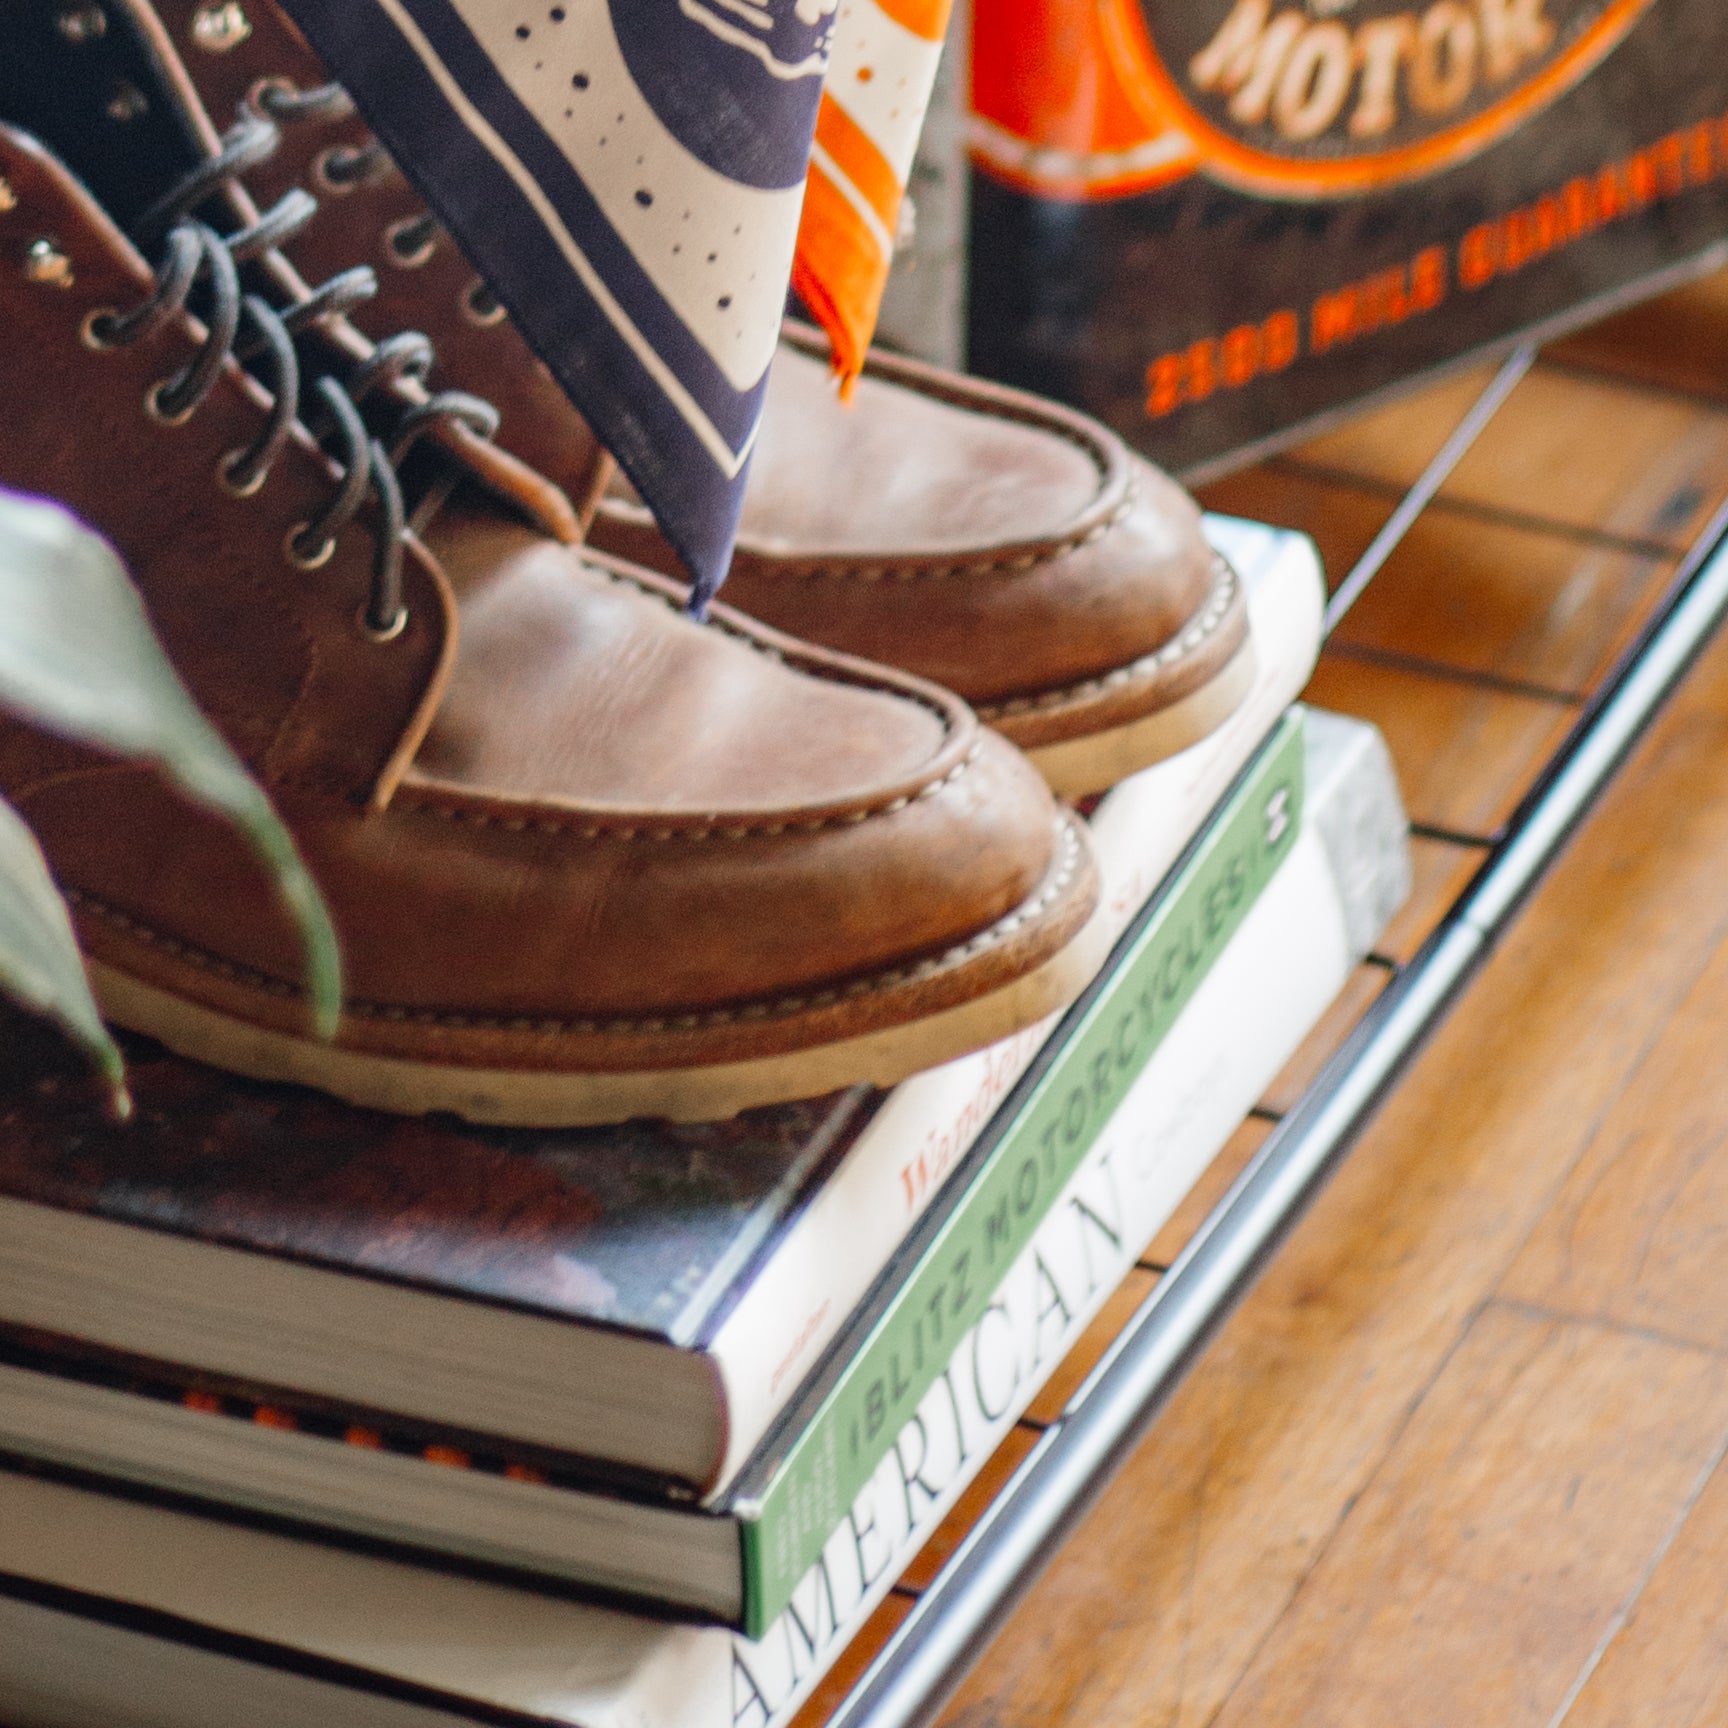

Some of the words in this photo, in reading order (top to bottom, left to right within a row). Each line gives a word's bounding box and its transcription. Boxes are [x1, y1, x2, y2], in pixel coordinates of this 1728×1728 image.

[1459, 112, 1728, 290] GUARANTE
[732, 1154, 1124, 1724] AMERICAN
[864, 1248, 972, 1442] BLITZ
[983, 866, 1247, 1260] MOTORCYCLES
